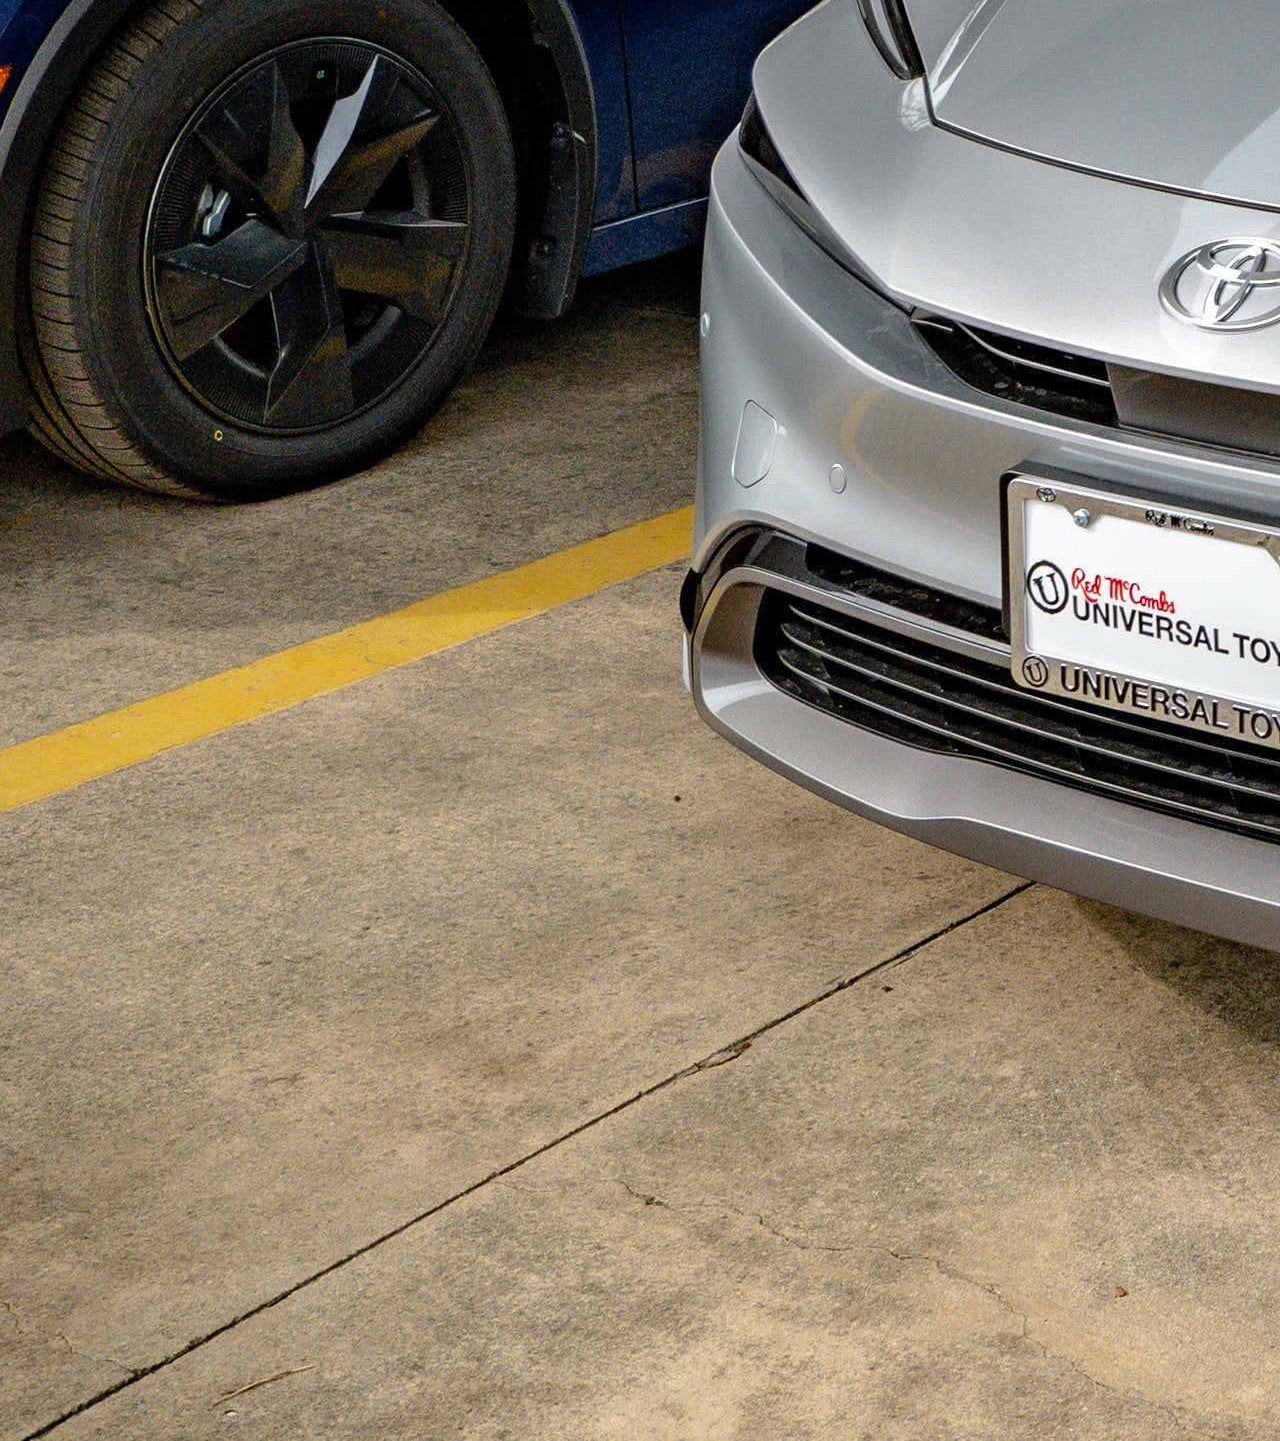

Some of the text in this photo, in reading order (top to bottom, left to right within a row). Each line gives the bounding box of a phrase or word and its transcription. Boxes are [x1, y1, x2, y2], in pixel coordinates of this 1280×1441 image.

[1071, 567, 1176, 615] Red McCombs
[1072, 594, 1229, 656] UNIVERSAL
[1060, 662, 1229, 730] UNIVERSAL
